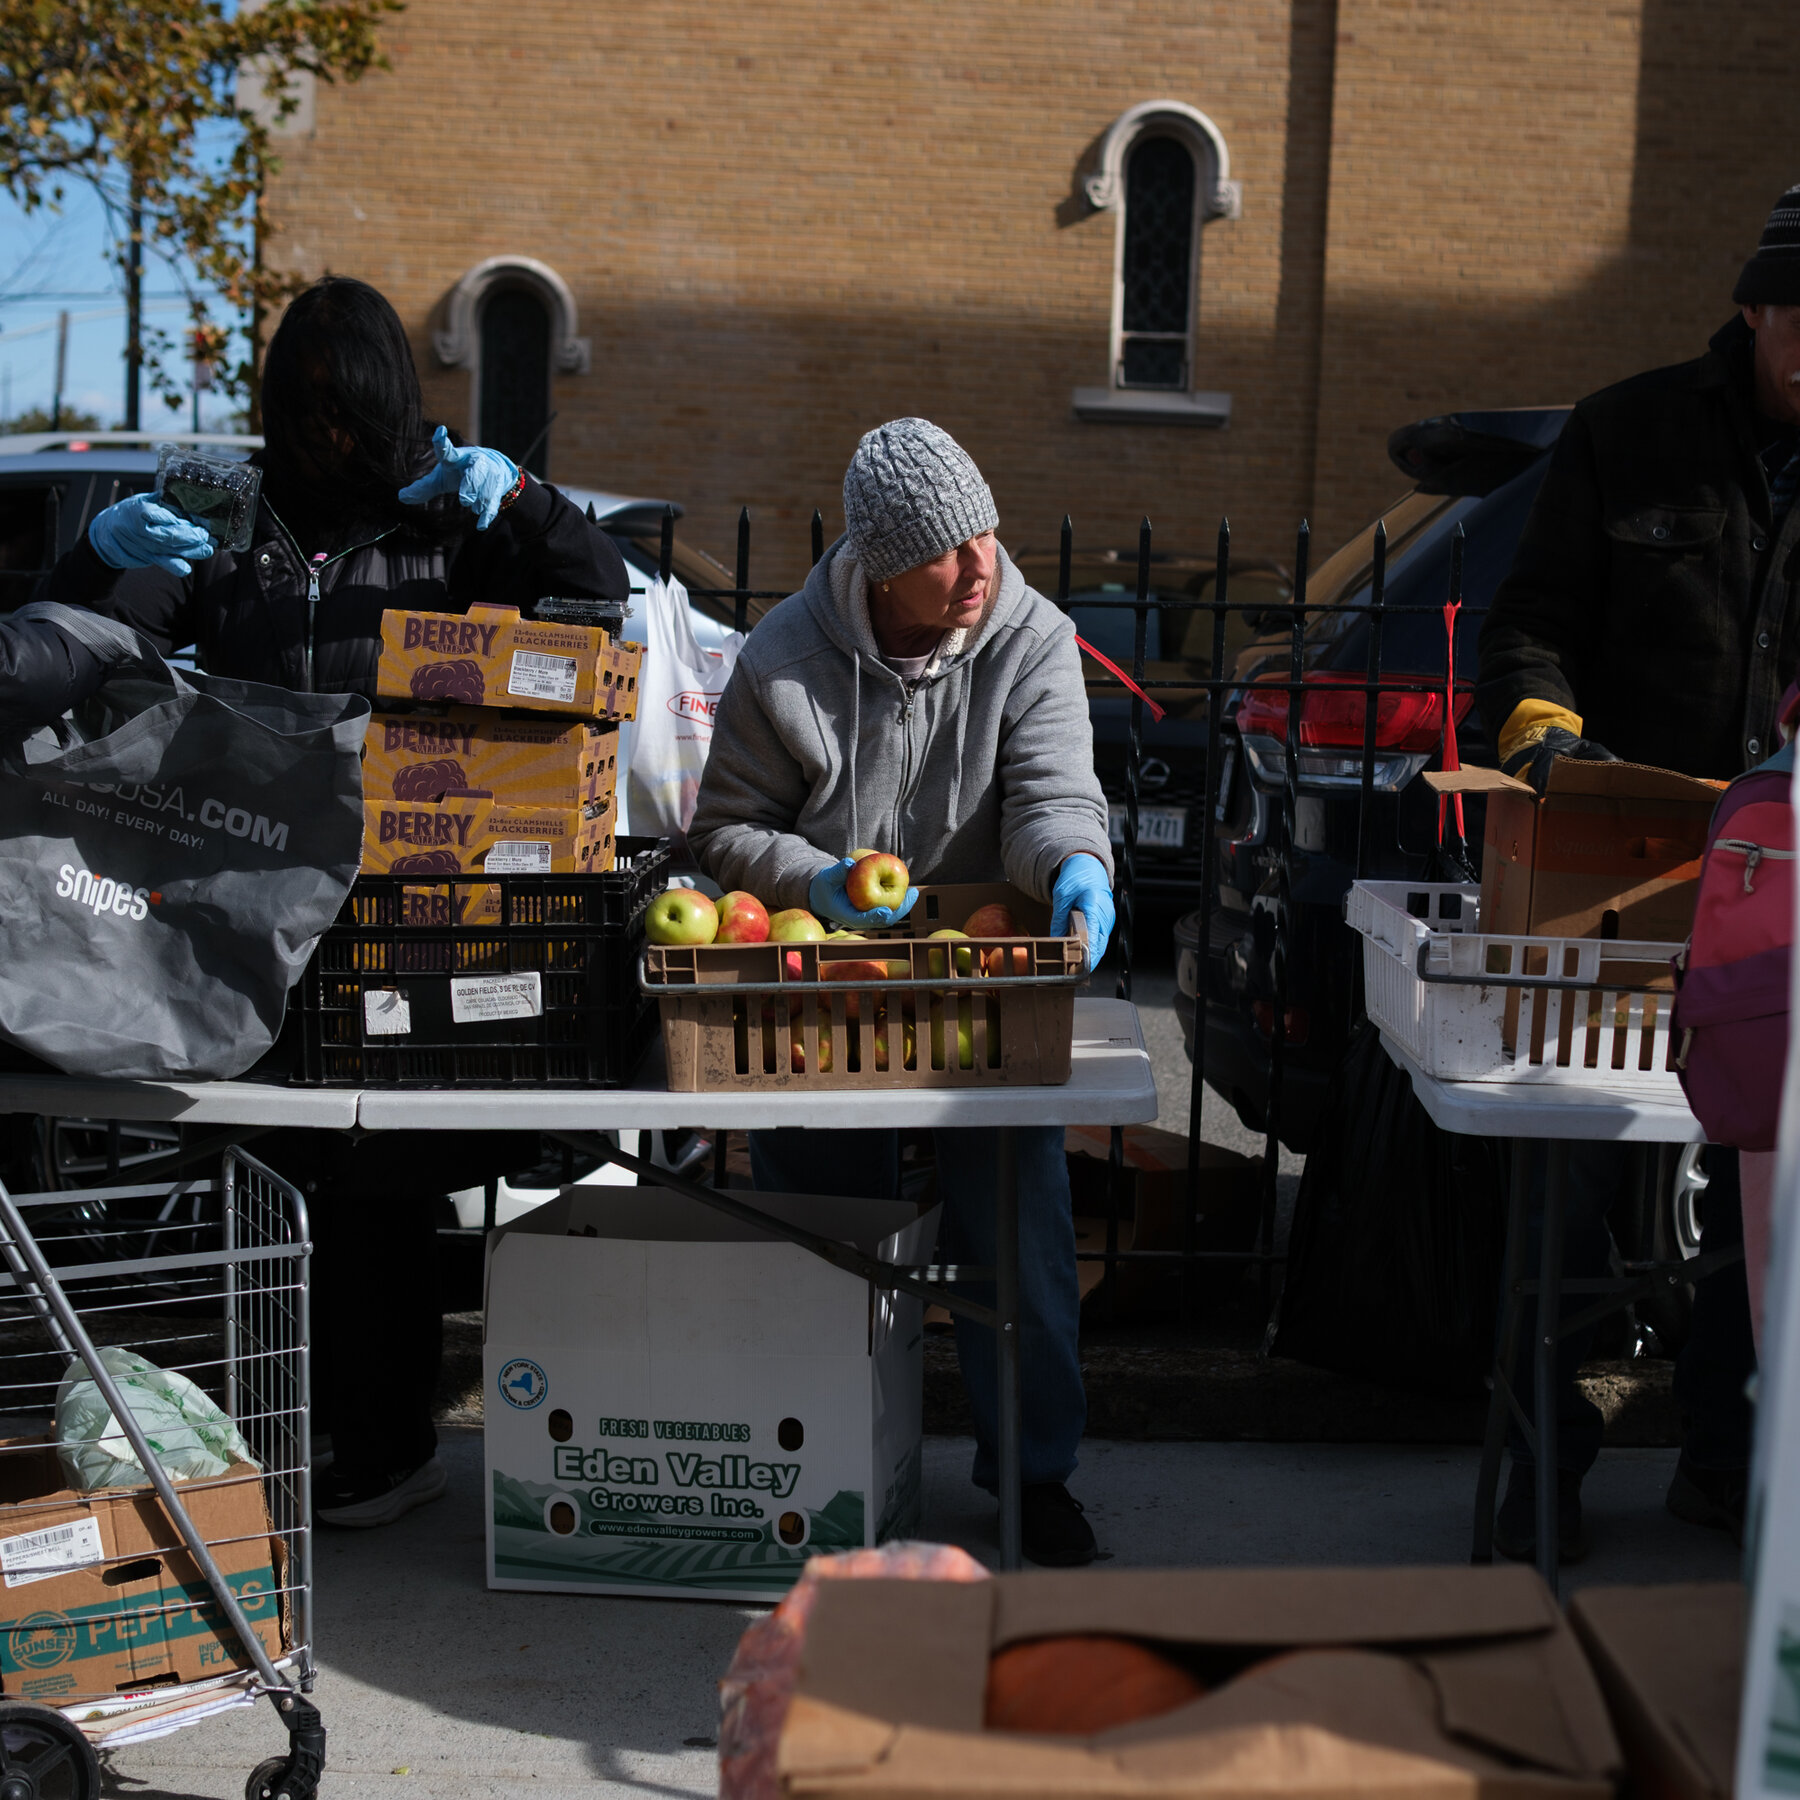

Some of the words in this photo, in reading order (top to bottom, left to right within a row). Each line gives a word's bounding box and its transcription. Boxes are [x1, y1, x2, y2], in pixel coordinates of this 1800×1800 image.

[403, 617, 500, 659] BERRY
[513, 636, 590, 650] BLACKBERRIES
[537, 630, 589, 642] CLAMSHELLS
[434, 643, 467, 655] VALLEY
[383, 719, 479, 757] BERRY
[493, 734, 569, 745] BLACKBERRIES
[415, 745, 448, 755] VALLEY
[42, 791, 71, 808] ALL
[75, 799, 110, 820] DAY!
[115, 811, 166, 836] EVERY
[169, 829, 206, 851] DAY!
[380, 810, 476, 848] BERRY
[514, 818, 564, 828] CLAMSHELLS
[488, 825, 565, 836] BLACKBERRIES
[410, 835, 443, 846] VALLEY
[457, 988, 479, 997] GOLDEN
[504, 984, 511, 992] DE
[519, 983, 528, 991] DE
[503, 1366, 514, 1379] NEW
[530, 1365, 544, 1381] STATE
[600, 1418, 648, 1439] FRESH
[654, 1420, 751, 1443] VEGETABLES
[554, 1446, 658, 1486] Eden
[666, 1451, 801, 1498] Valley
[589, 1487, 703, 1516] Growers
[711, 1493, 764, 1518] Inc.
[598, 1523, 755, 1540] www.edenvalleygrowers.com
[13, 1637, 75, 1661] SUNSET
